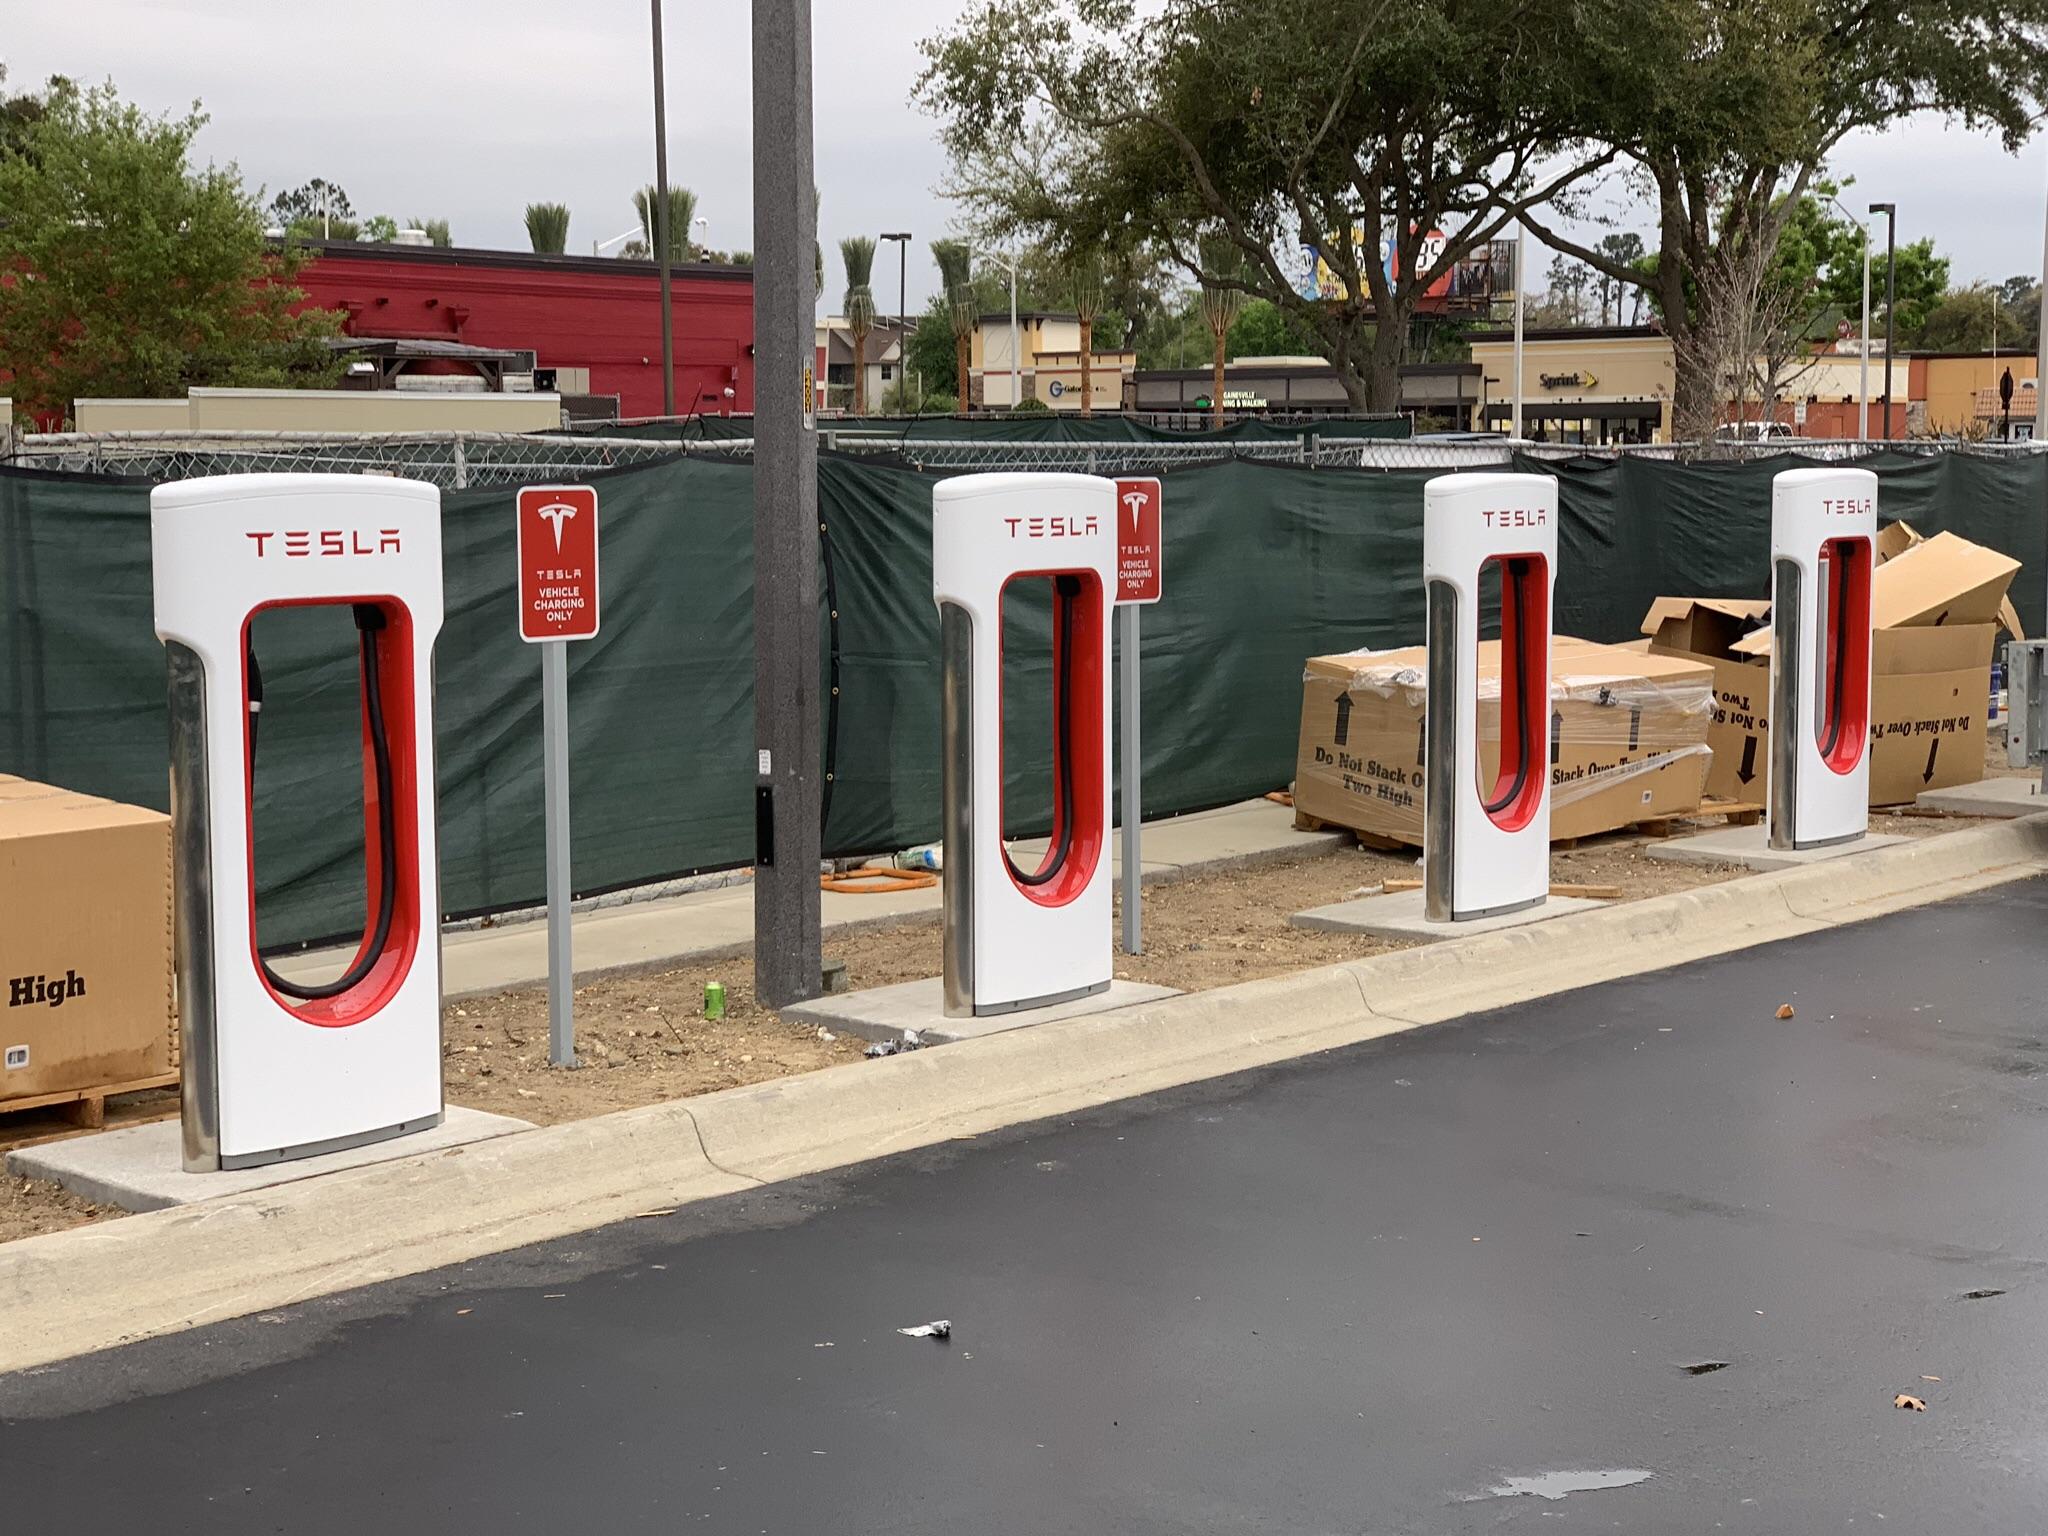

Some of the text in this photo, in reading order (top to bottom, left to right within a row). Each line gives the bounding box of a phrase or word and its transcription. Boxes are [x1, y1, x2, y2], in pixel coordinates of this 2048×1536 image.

[1539, 372, 1580, 390] Sprint
[1223, 391, 1255, 399] GAINESVILLE
[1241, 399, 1268, 408] WALKING
[1822, 499, 1871, 515] TESLA
[1482, 509, 1546, 528] TESLA
[1004, 516, 1098, 538] TESLA
[245, 529, 401, 558] TESLA
[1121, 545, 1151, 555] TESLA
[1122, 559, 1149, 569] VEHICLE
[536, 569, 582, 581] TESLA
[1119, 569, 1153, 580] CHARGING
[1126, 579, 1145, 589] ONLY
[539, 586, 580, 599] VEHICLE
[533, 598, 585, 611] CHARGING
[546, 611, 573, 622] ONLY
[1721, 690, 1750, 712] Two
[1887, 721, 1911, 737] Over
[1914, 719, 1940, 736] Stack
[1941, 717, 1957, 733] Not
[1958, 716, 1970, 731] Do
[1315, 746, 1334, 765] Do
[1339, 751, 1363, 773] Not
[1367, 760, 1407, 785] Stack
[1552, 764, 1584, 786] Stack
[1343, 773, 1413, 807] Two High
[8, 969, 87, 1008] High
